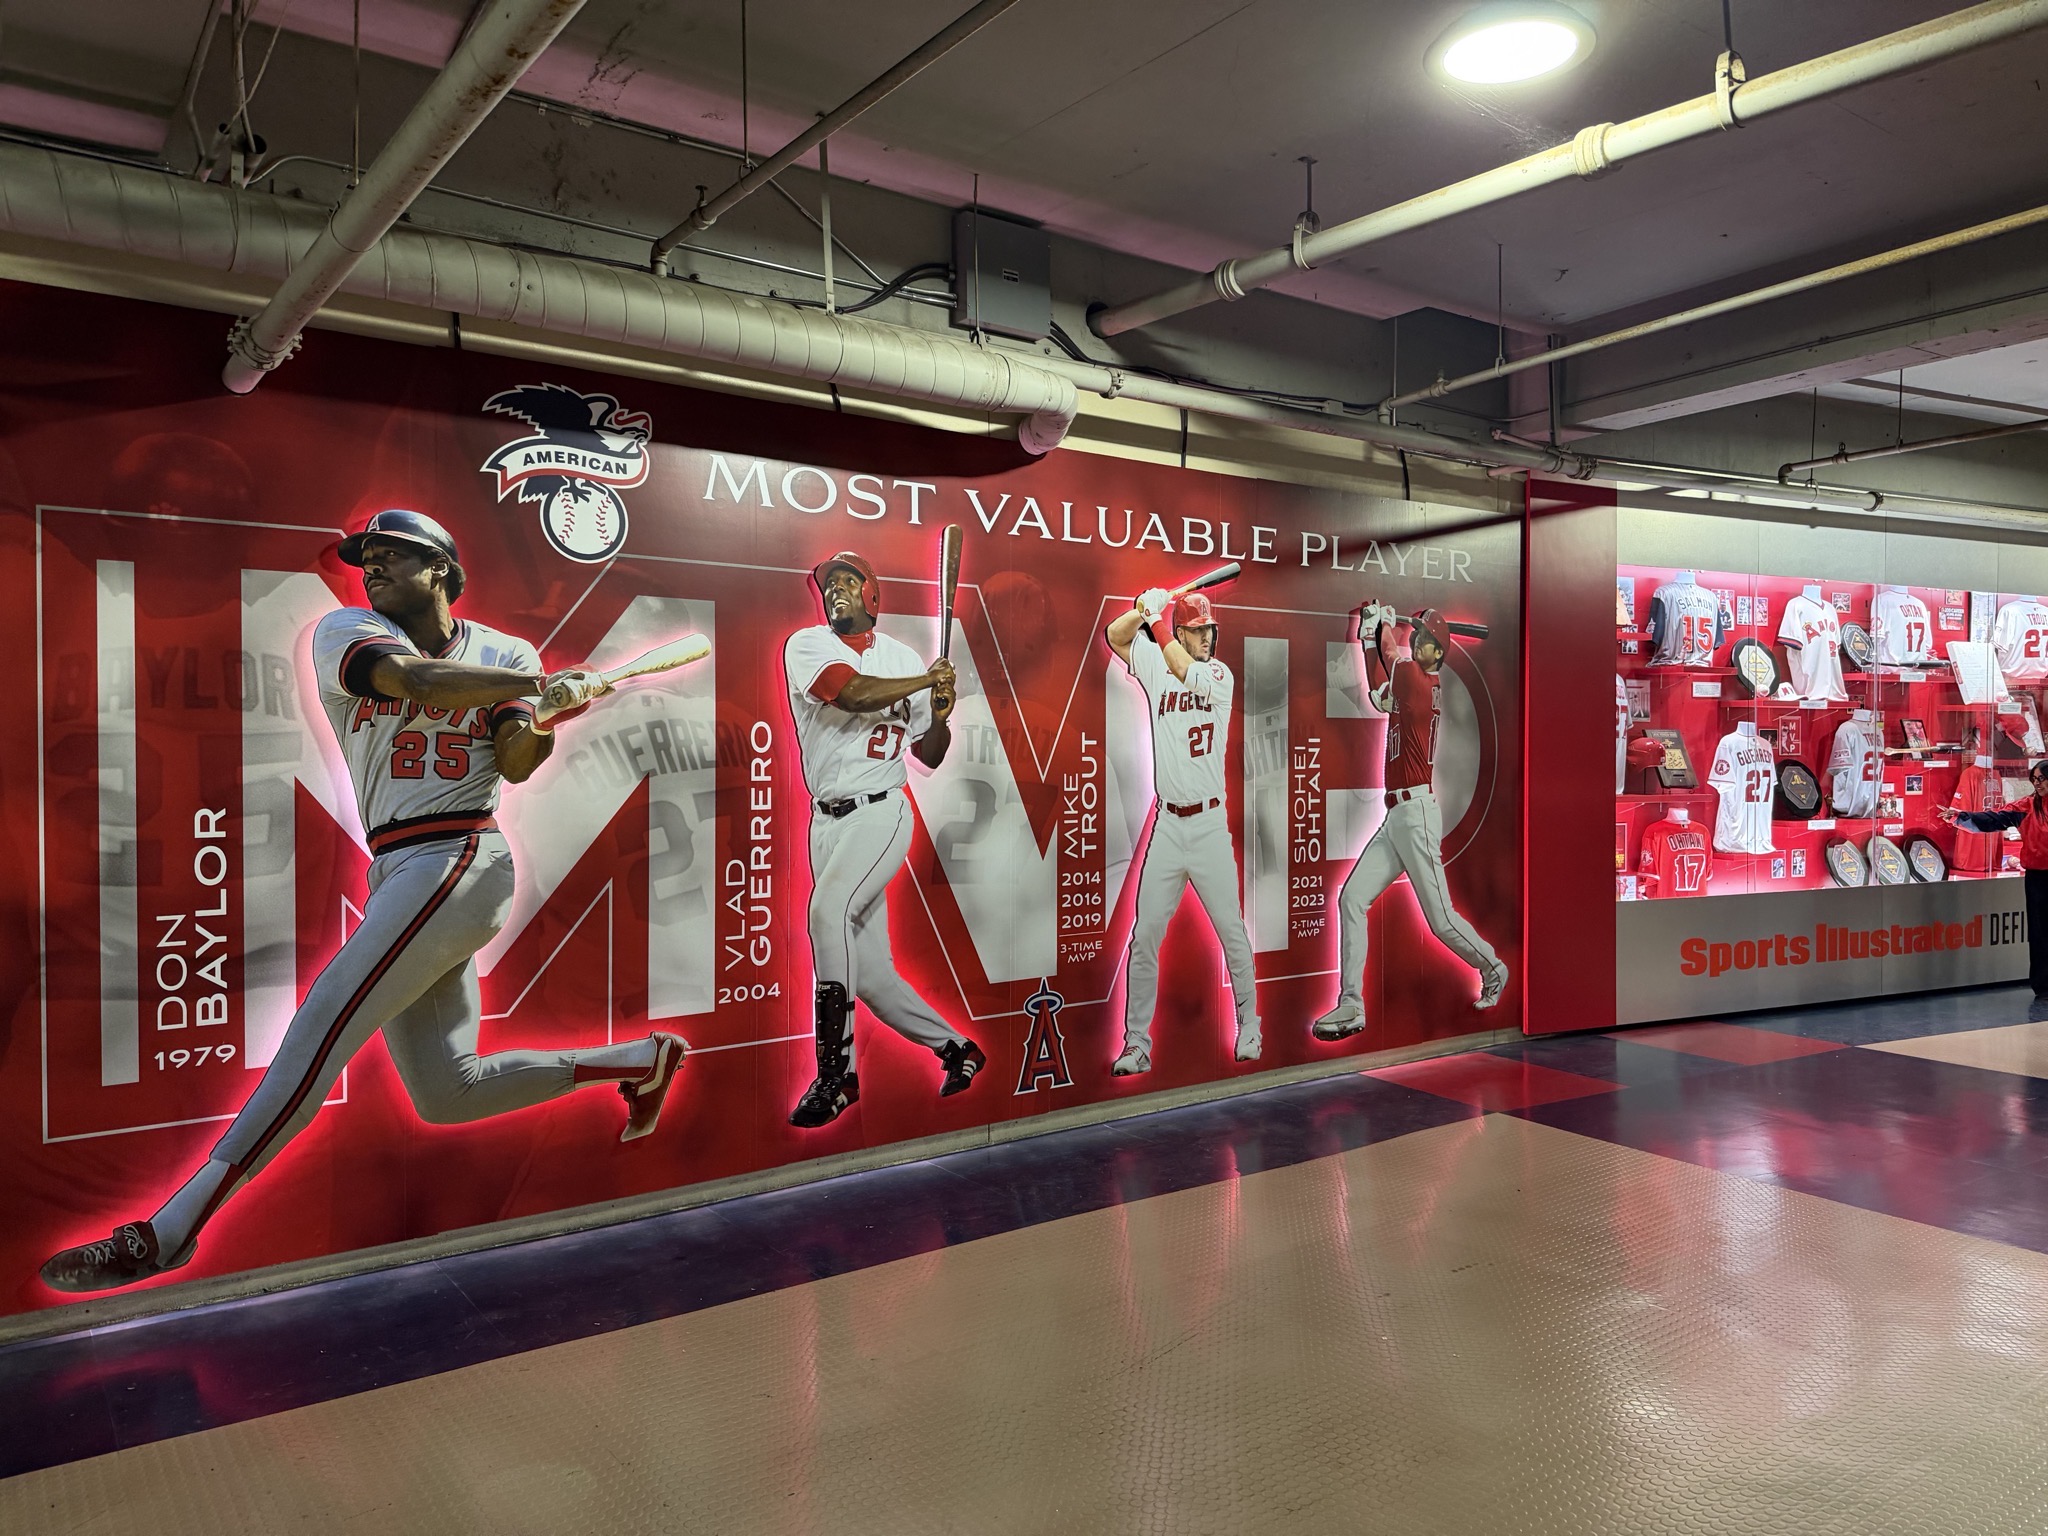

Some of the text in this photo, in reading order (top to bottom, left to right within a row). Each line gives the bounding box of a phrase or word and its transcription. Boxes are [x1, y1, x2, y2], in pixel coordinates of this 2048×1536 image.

[523, 451, 628, 475] AMERICAN
[702, 454, 1474, 583] MOST VALUABLE PLAYER
[1677, 597, 1713, 612] SALMON
[1899, 604, 1924, 618] OHTAN
[1682, 615, 1713, 654] 15
[1906, 621, 1925, 653] 17
[53, 647, 298, 722] BAYLOR
[391, 730, 473, 782] 25
[867, 723, 906, 761] 27
[1188, 722, 1214, 758] 27
[1081, 732, 1097, 859] TROUT
[1308, 738, 1321, 863] OHTANI
[1745, 769, 1771, 803] 27
[1063, 773, 1078, 859] MIKE
[1294, 746, 1306, 863] SHOHEI
[750, 721, 772, 966] GUERRERO
[1667, 832, 1706, 852] OHTANI
[1061, 871, 1101, 886] 2014
[1292, 876, 1323, 889] 2021
[1674, 853, 1706, 892] 17
[194, 808, 228, 1026] BAYLOR
[725, 859, 746, 971] VLAD
[1061, 892, 1102, 908] 2016
[1292, 894, 1325, 908] 2023
[1061, 913, 1102, 929] 2019
[1291, 918, 1325, 930] 2-TIME
[1297, 928, 1320, 938] MVP
[1060, 940, 1103, 953] 3-TIME
[1067, 952, 1096, 964] MVP
[1680, 911, 2025, 977] Sports Illustrated DEFI
[156, 914, 188, 1031] DON
[718, 982, 781, 1004] 2004
[1013, 976, 1075, 1096] A
[154, 1044, 236, 1070] 1979
